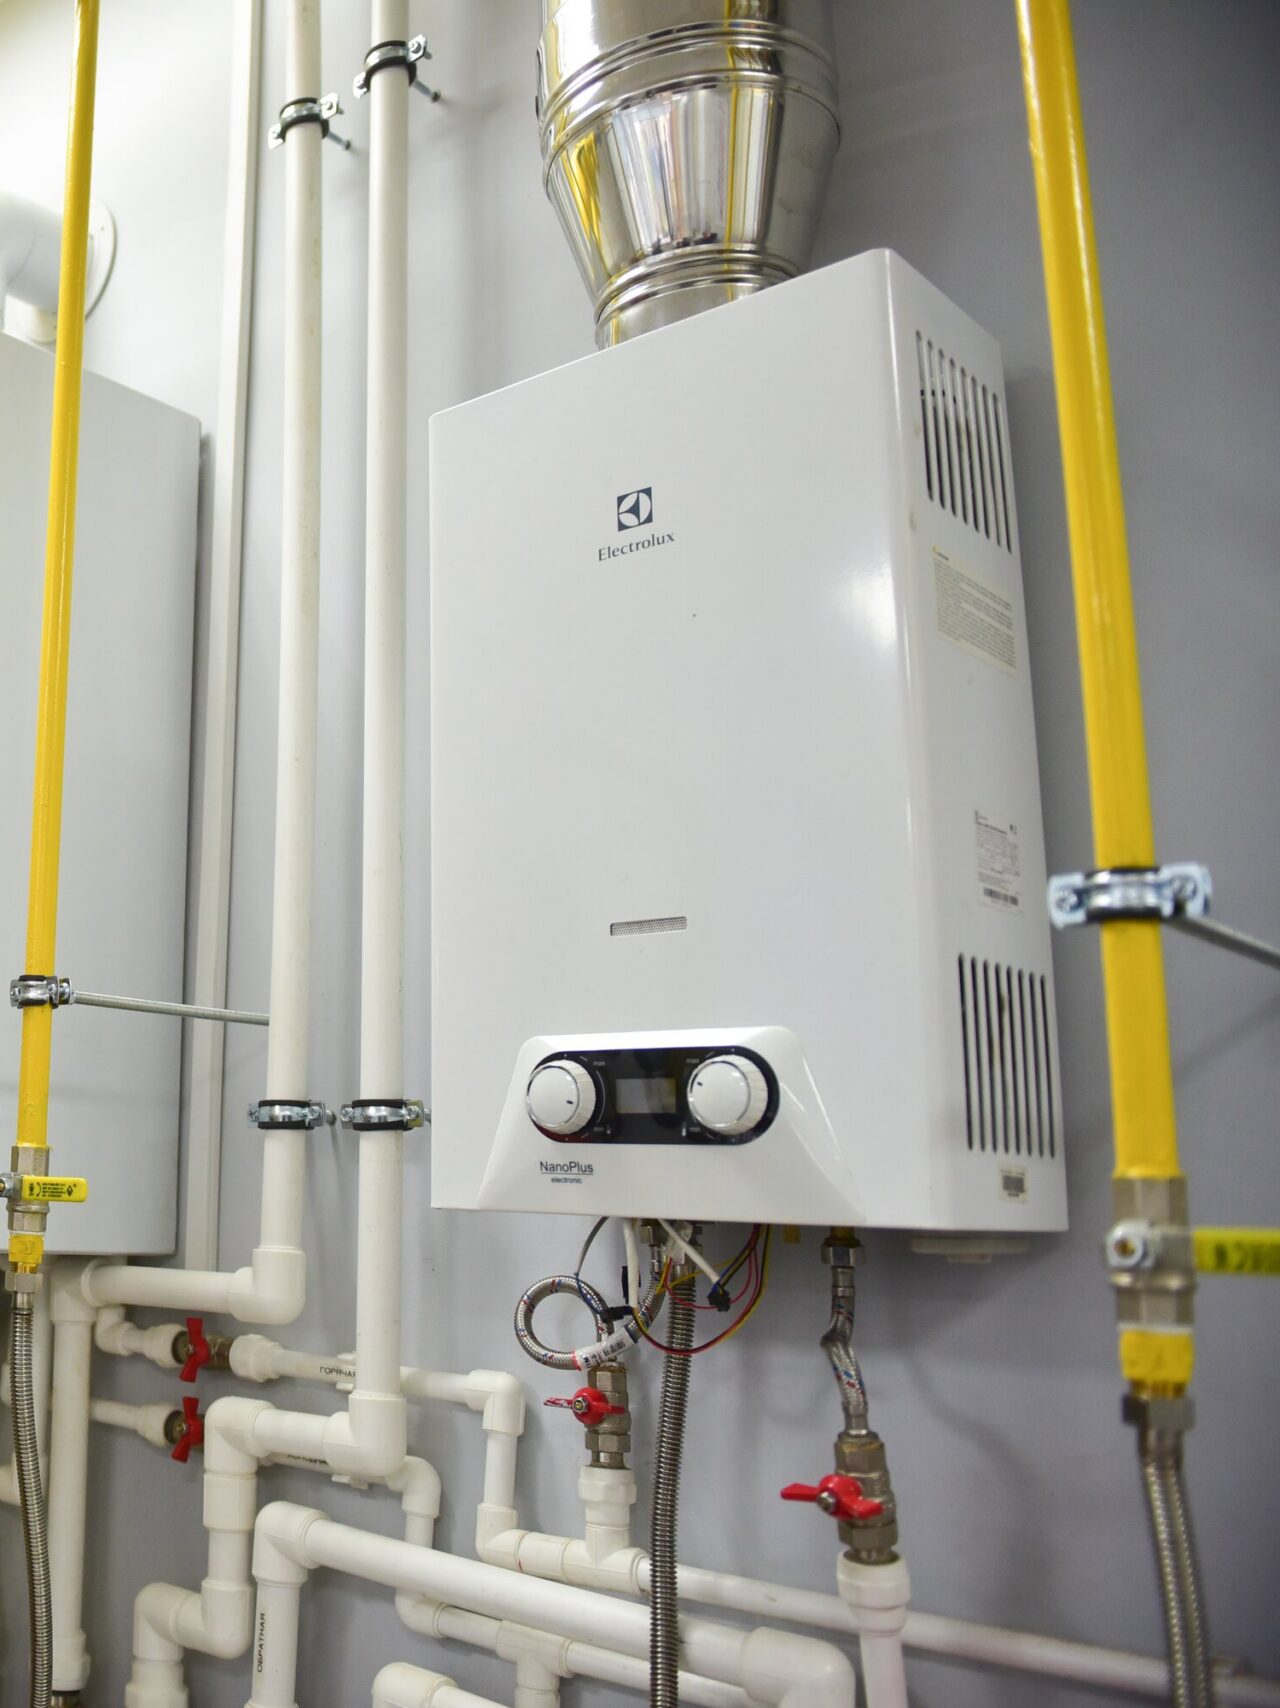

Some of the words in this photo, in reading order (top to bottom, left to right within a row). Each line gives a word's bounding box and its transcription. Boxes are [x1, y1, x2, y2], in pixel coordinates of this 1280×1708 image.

[598, 532, 675, 562] Electrolux
[539, 1160, 594, 1173] NanoPlus
[256, 1612, 266, 1673] ОБРАТНАЯ
